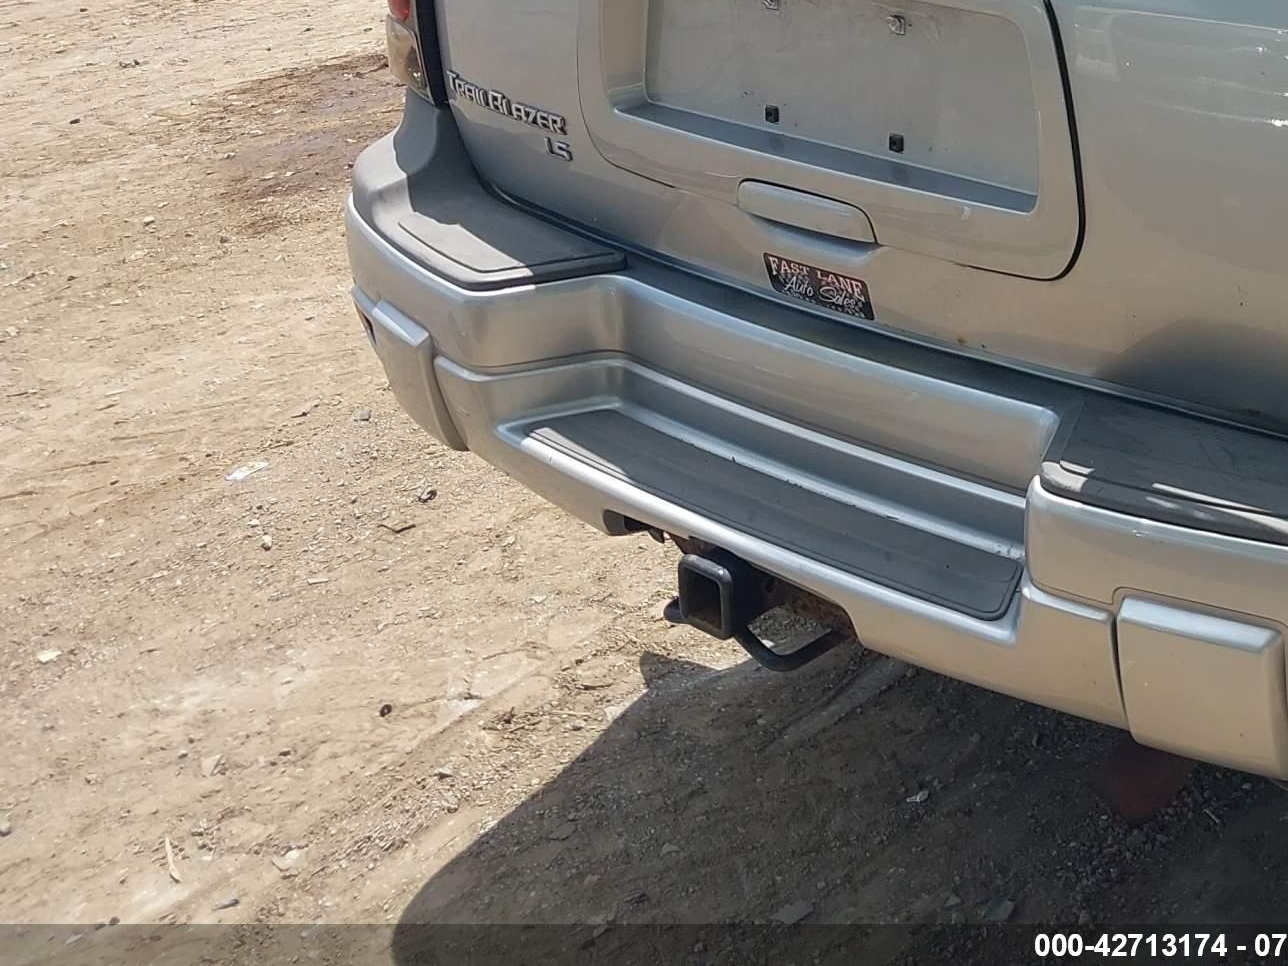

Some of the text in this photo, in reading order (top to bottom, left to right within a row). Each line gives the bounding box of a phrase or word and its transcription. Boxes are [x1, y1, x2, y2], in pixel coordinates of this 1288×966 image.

[544, 137, 573, 162] LS
[768, 256, 866, 303] FAST LANE
[784, 275, 856, 309] Auto Sales
